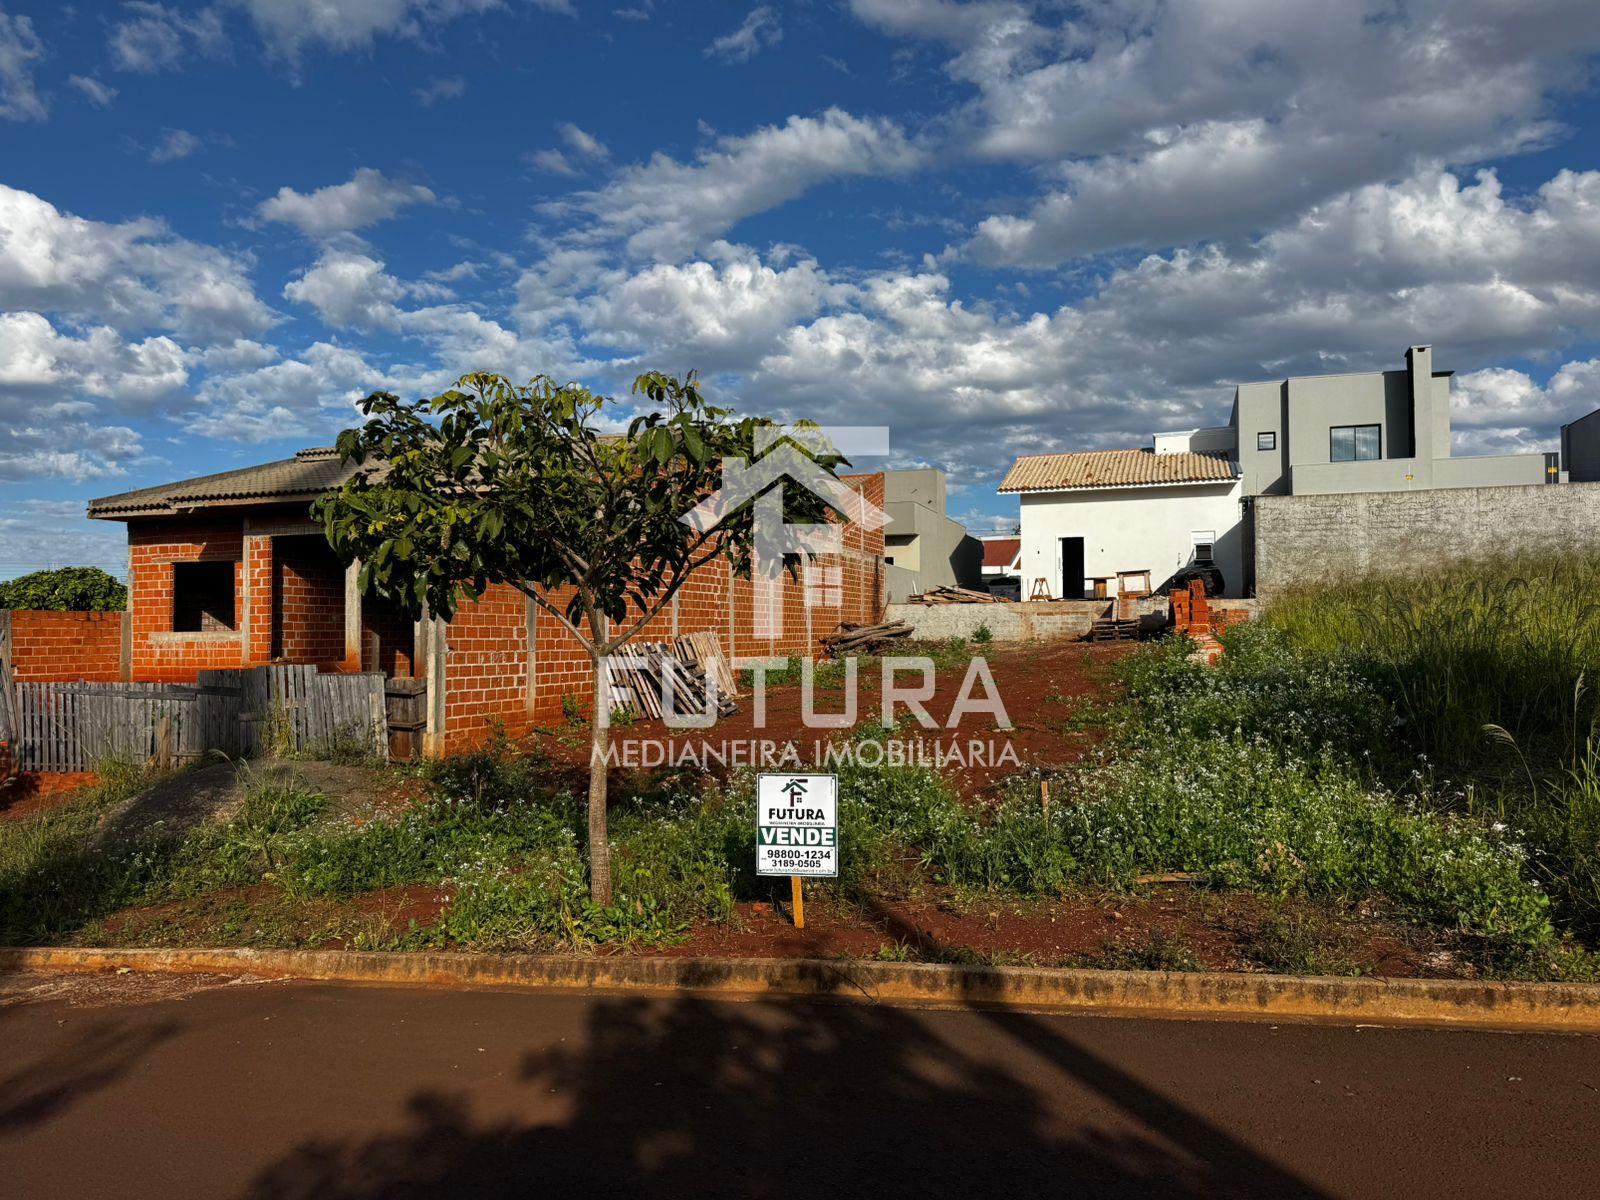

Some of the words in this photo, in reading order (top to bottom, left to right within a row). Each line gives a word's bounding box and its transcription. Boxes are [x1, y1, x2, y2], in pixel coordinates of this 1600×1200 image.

[769, 808, 825, 820] FUTURA
[761, 828, 834, 845] VENDE
[767, 849, 831, 859] 98800-1234
[772, 859, 821, 868] 3189-0505
